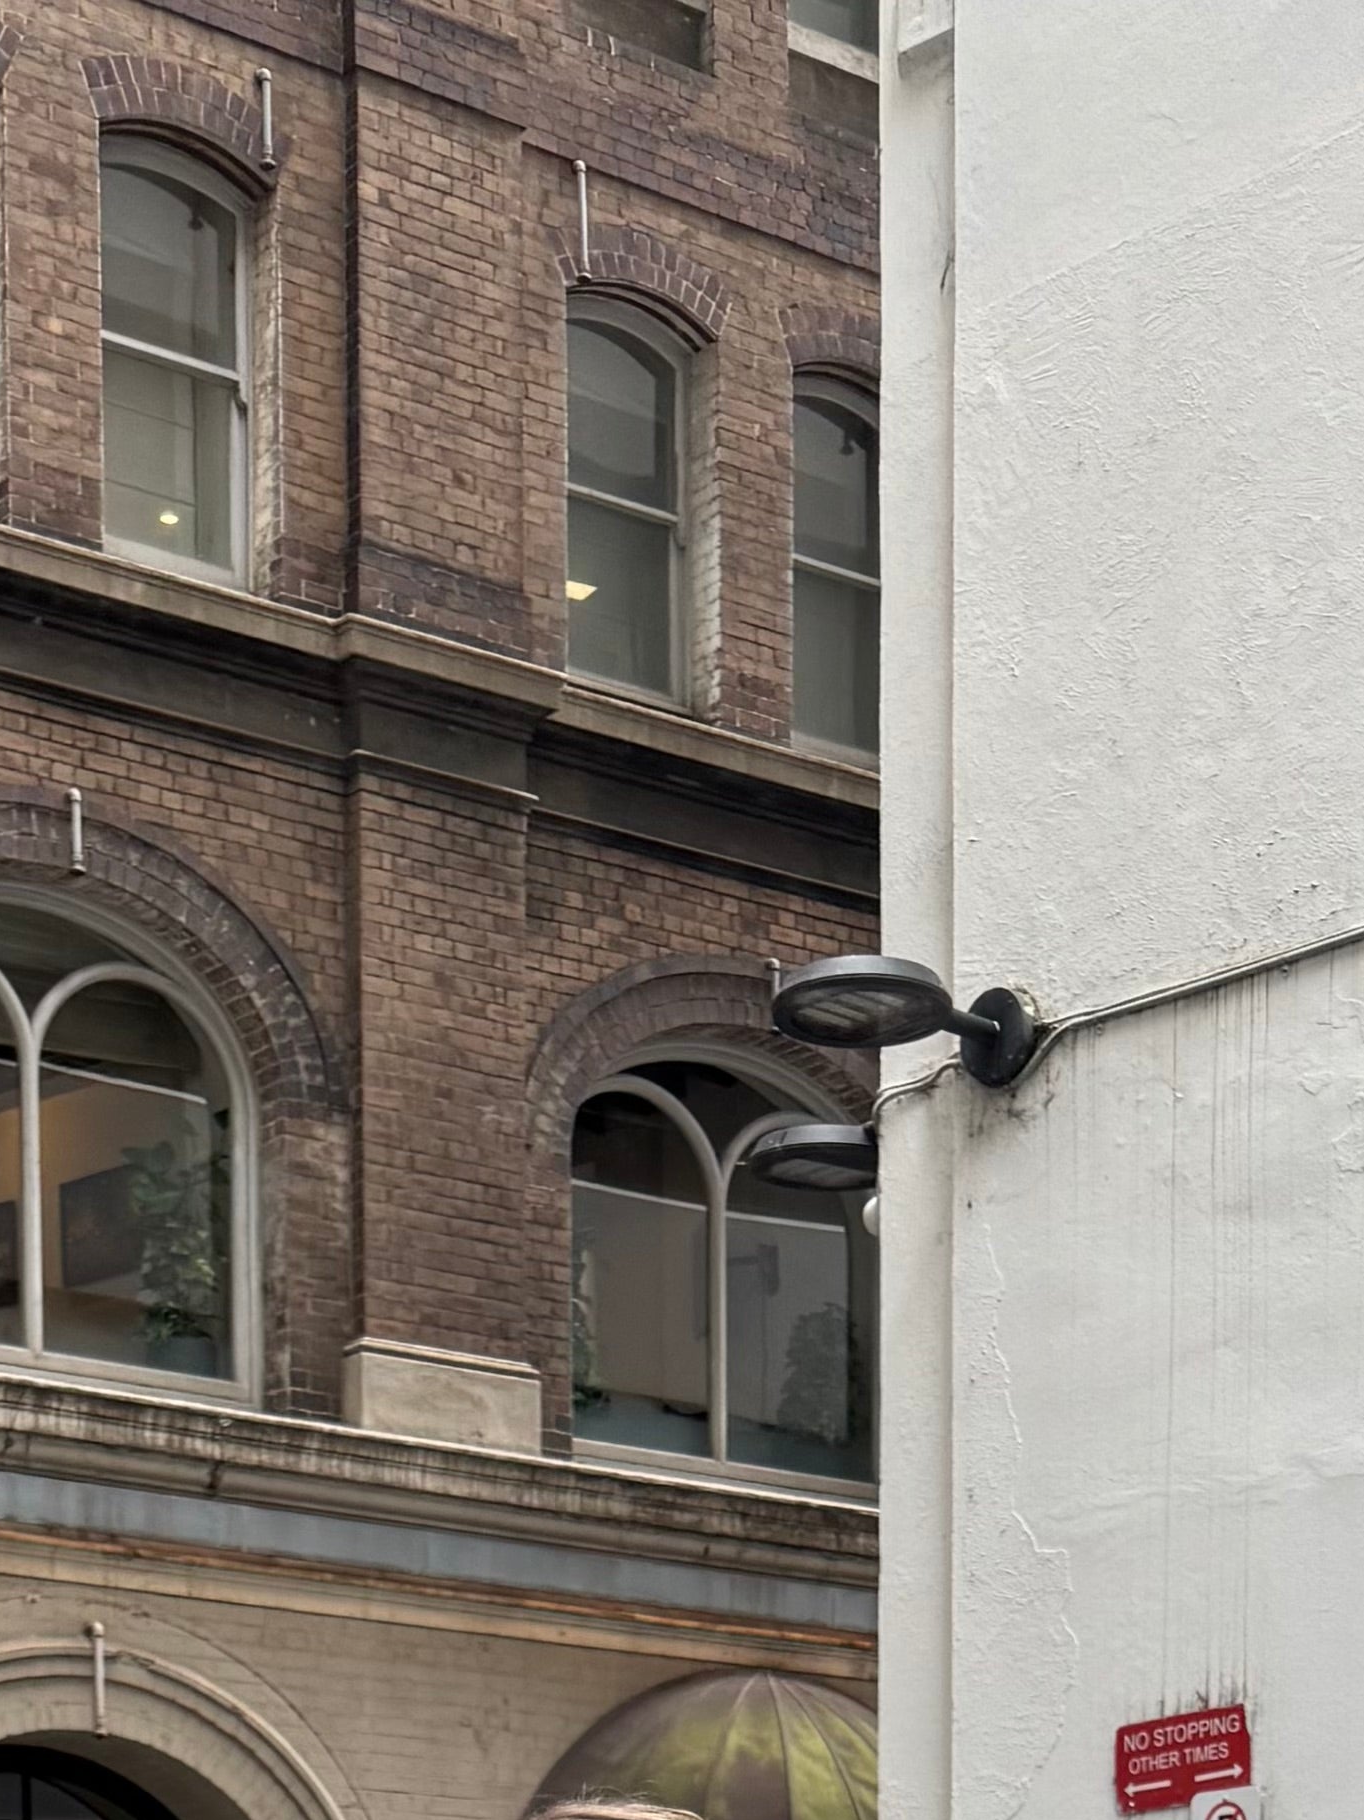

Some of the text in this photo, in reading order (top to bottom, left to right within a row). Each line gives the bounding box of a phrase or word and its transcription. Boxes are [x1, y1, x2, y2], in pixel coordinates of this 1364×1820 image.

[1123, 1714, 1241, 1753] NO STOPPING
[1128, 1742, 1230, 1775] OTHER TIMES
